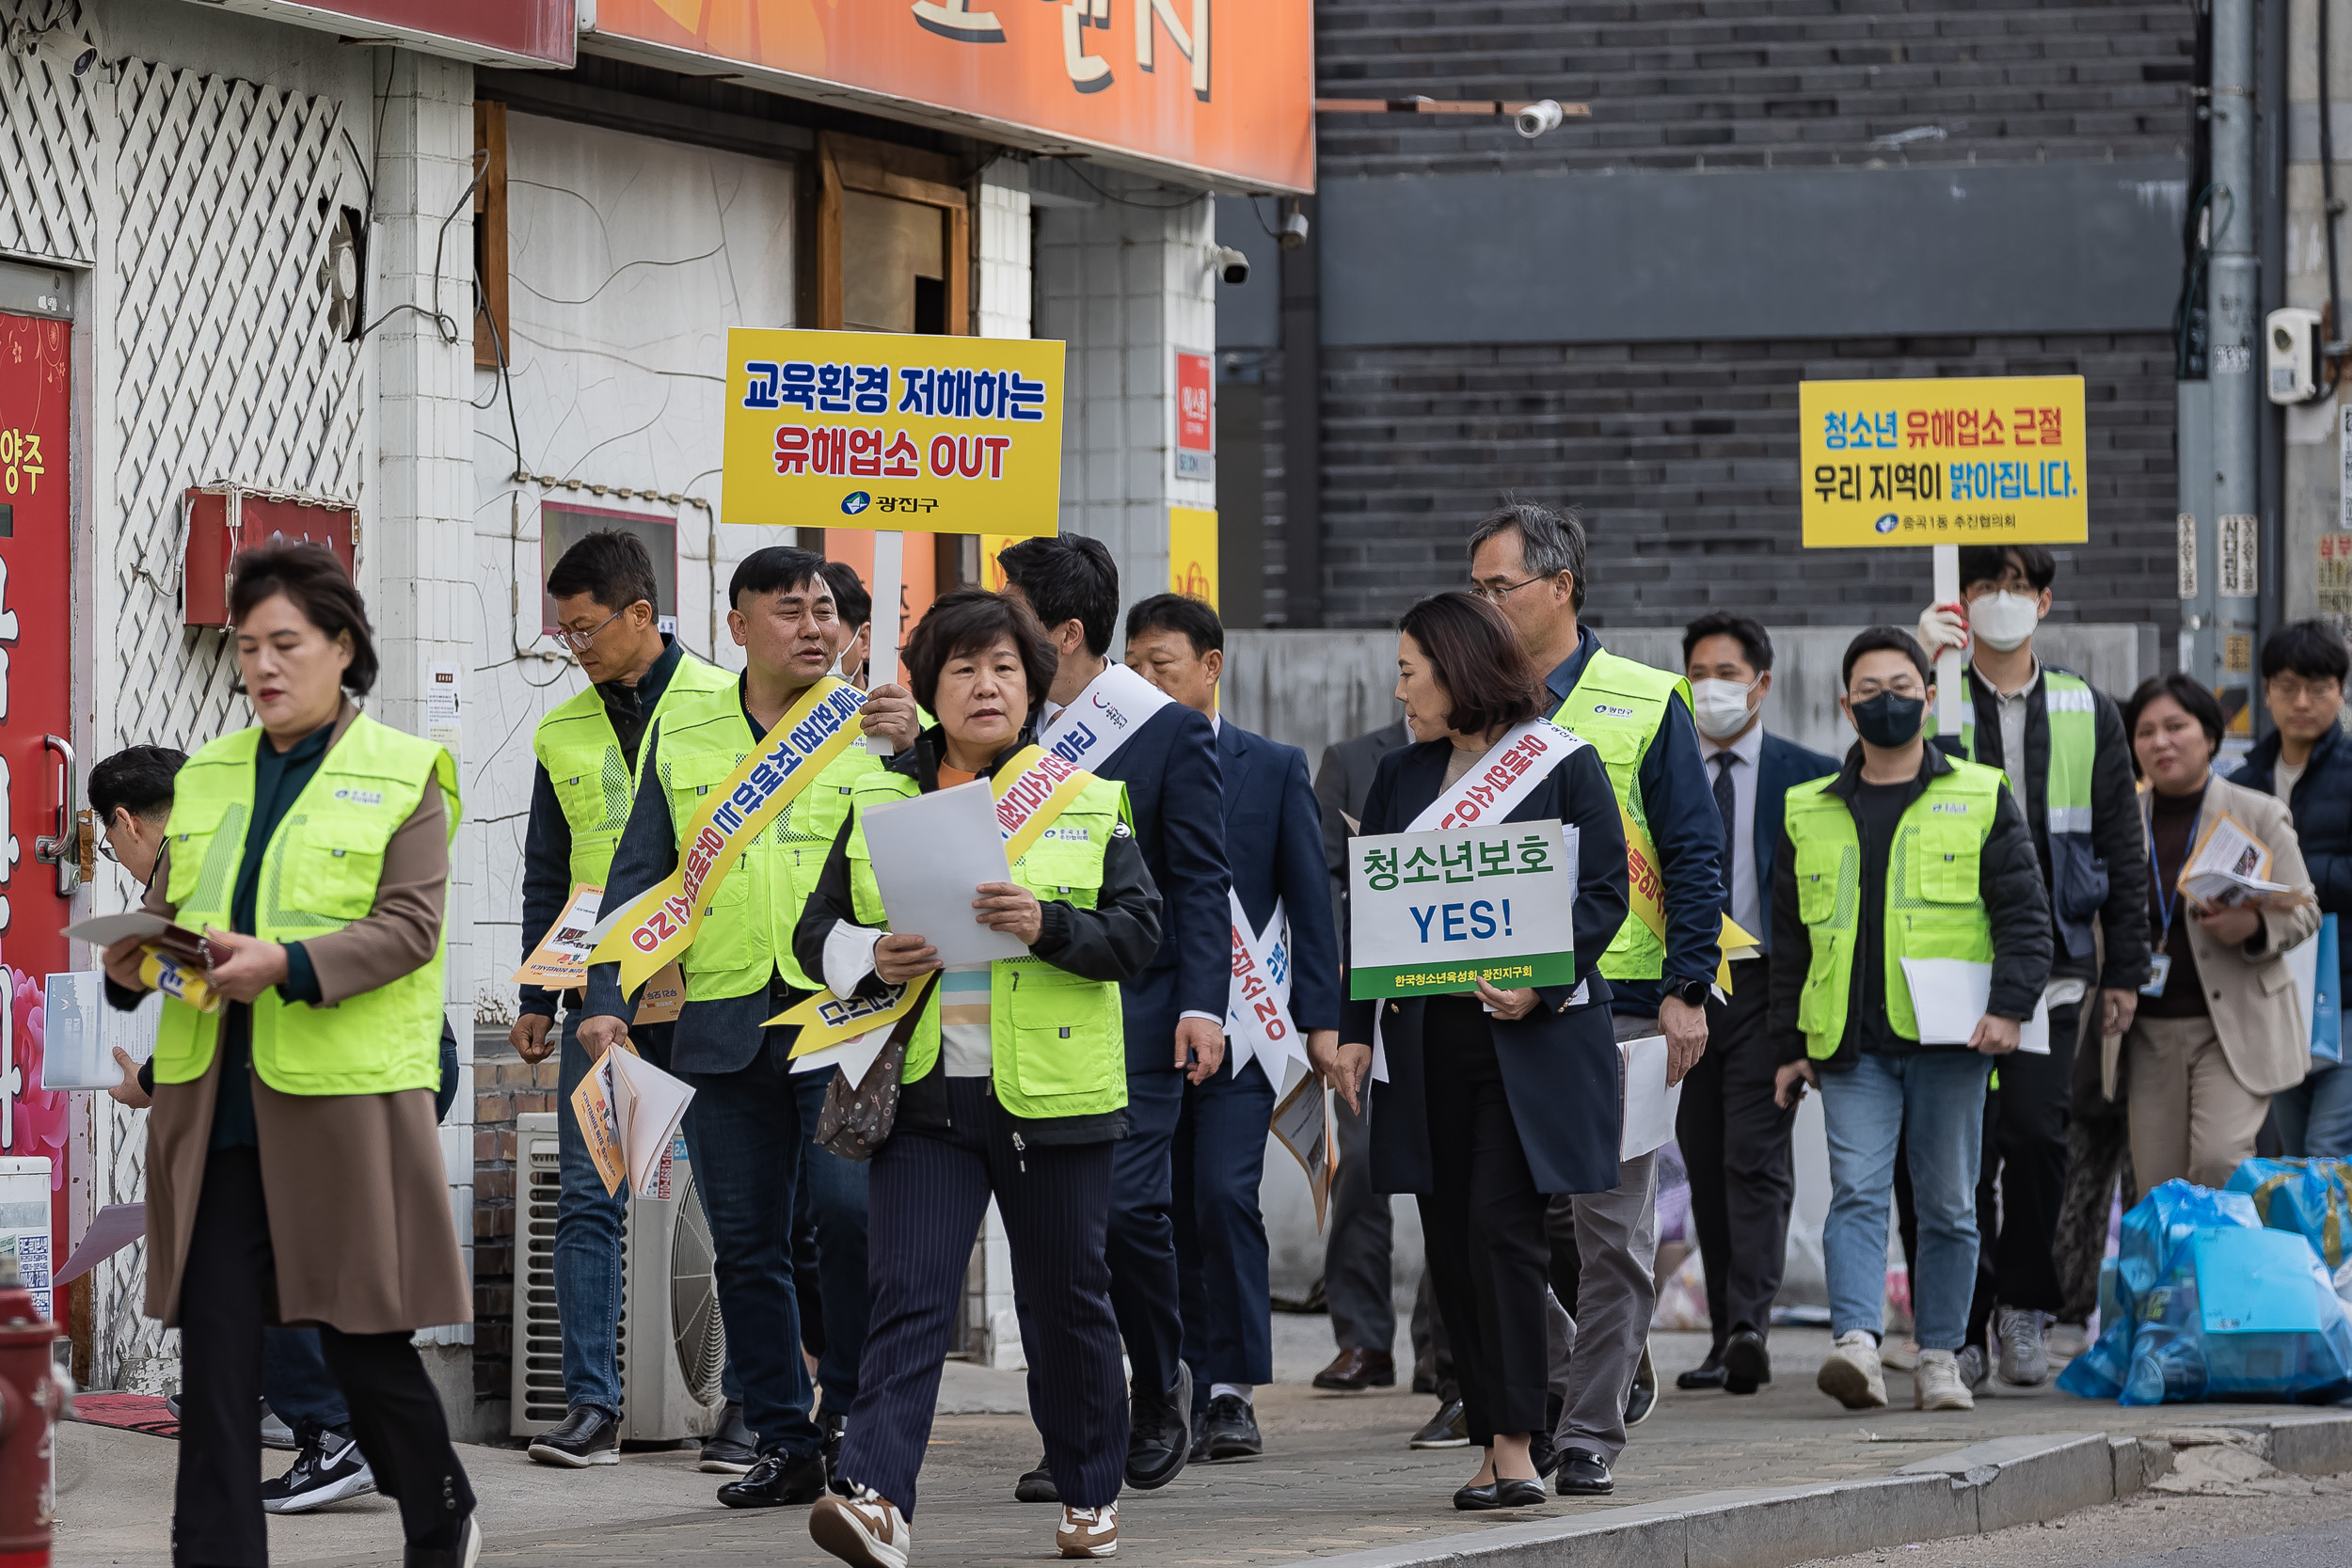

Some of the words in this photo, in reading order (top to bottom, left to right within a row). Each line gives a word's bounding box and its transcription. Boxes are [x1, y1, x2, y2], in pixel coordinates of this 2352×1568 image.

[742, 362, 890, 414] 교육환경
[898, 366, 1045, 420] 저해하는
[1824, 410, 1898, 451] 청소년
[1907, 408, 2005, 449] 유해업소
[2013, 406, 2062, 447] 근절
[774, 425, 919, 479] 유해업소
[930, 434, 1011, 480] OUT
[1814, 464, 1862, 502] 우리
[1869, 462, 1942, 501] 지역이
[1950, 459, 2078, 500] 밝아집니다.
[876, 497, 939, 514] 광진구
[712, 741, 803, 835] 저해하는
[1465, 733, 1549, 811] 유해업소
[666, 827, 725, 925] 유해업소
[1363, 834, 1554, 892] 청소년보호
[632, 911, 678, 953] NO
[1409, 898, 1513, 943] YES!
[1394, 970, 1477, 988] 한국청소년육성회
[1483, 965, 1533, 981] 광진지구회
[1253, 996, 1286, 1041] NO
